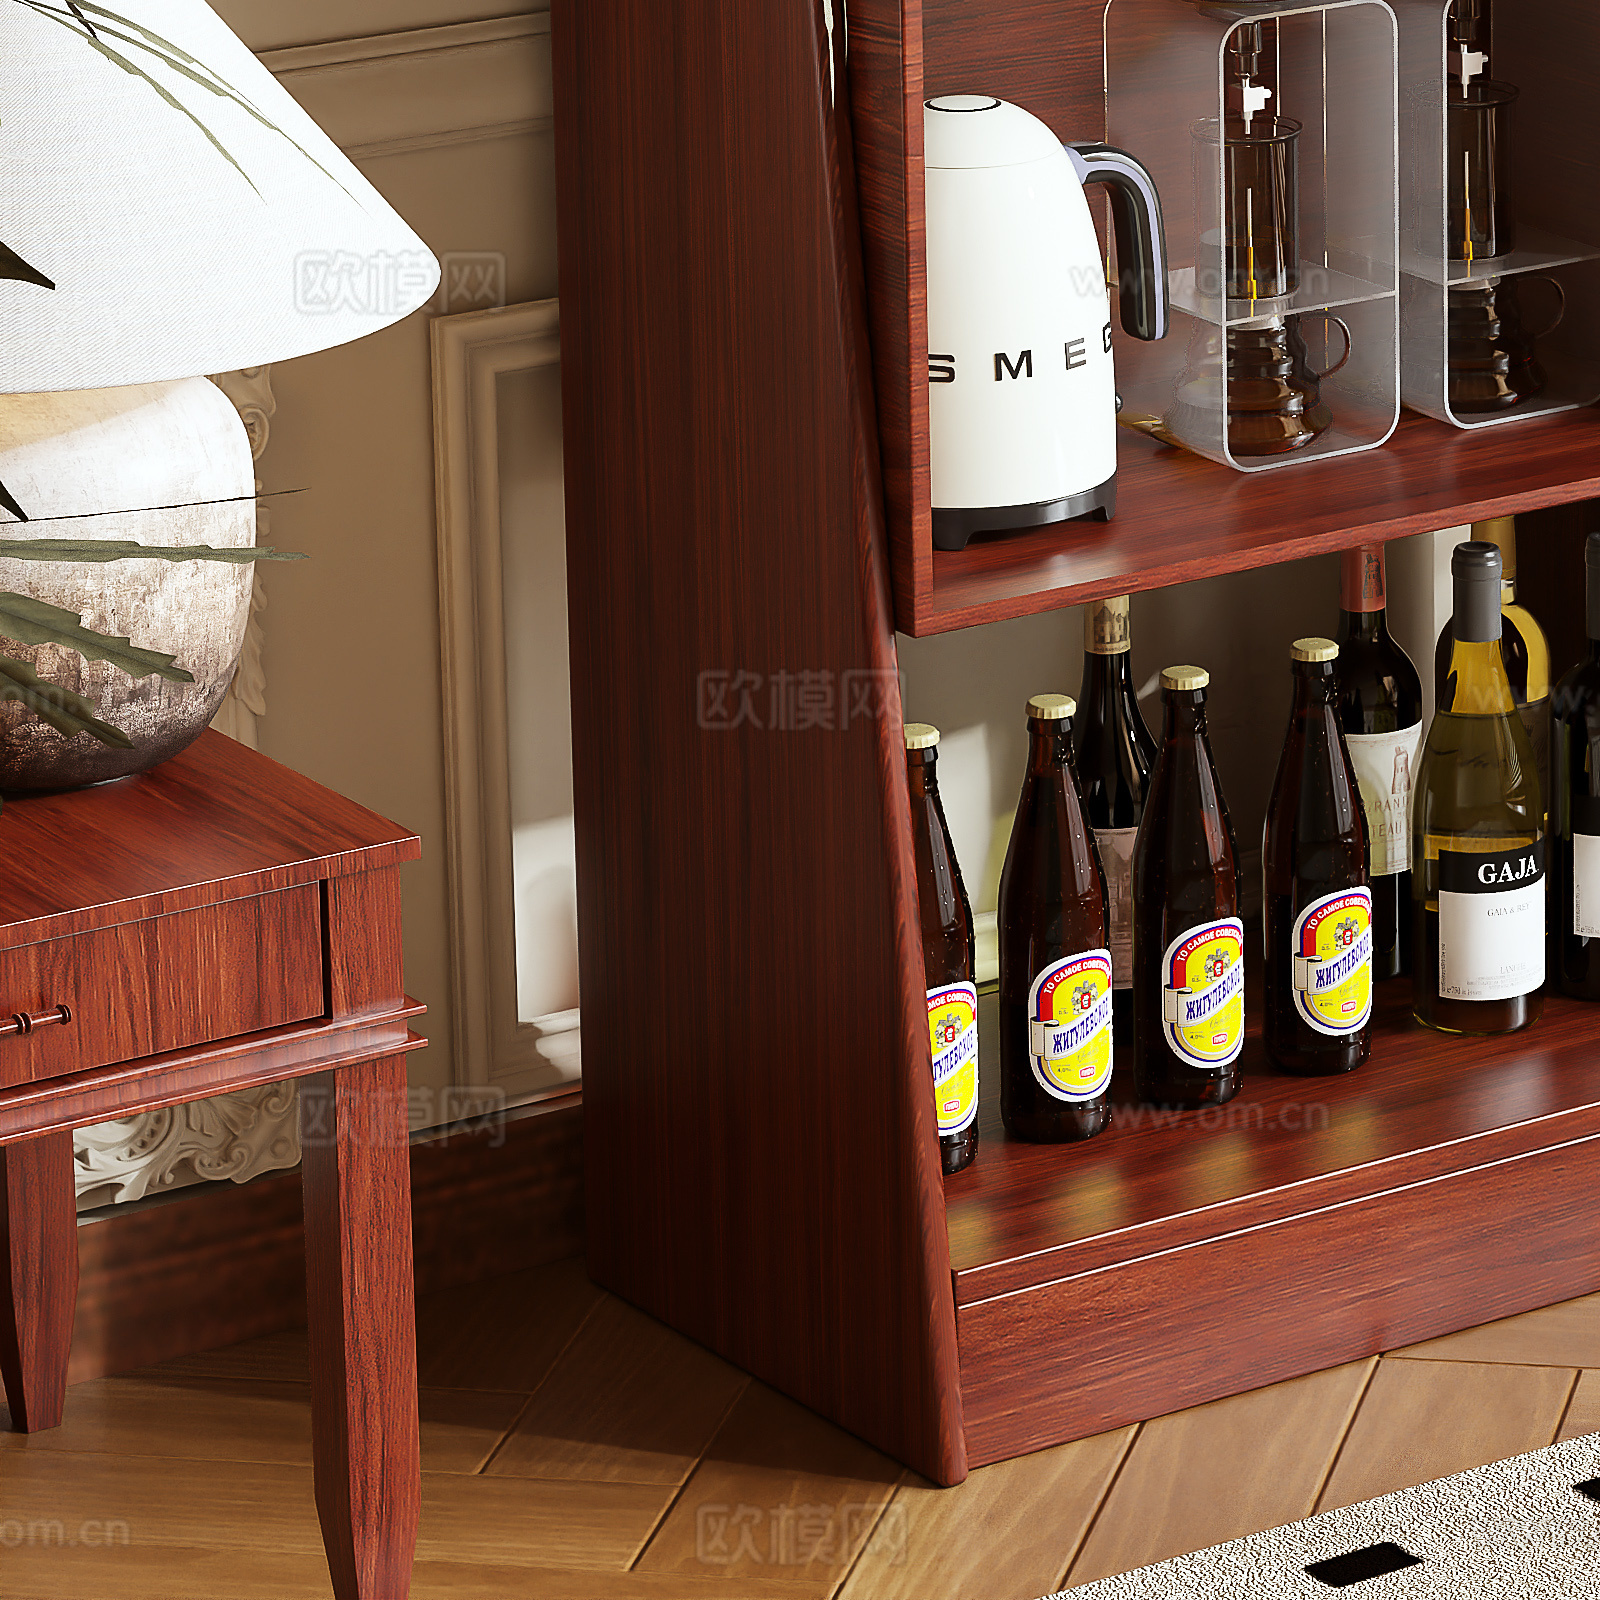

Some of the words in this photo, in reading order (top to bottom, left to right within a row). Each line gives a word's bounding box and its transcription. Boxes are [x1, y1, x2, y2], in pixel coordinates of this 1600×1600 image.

[1371, 820, 1402, 838] TEAU
[1477, 854, 1539, 884] GAJA
[1306, 919, 1318, 931] ТО
[1317, 899, 1345, 919] САМОЕ
[1176, 950, 1188, 962] ТО
[1187, 930, 1215, 951] САМОЕ
[1044, 982, 1055, 994] ТО
[1053, 962, 1083, 983] САМОЕ
[933, 1030, 973, 1081] ГУЛЕВСКОЕ
